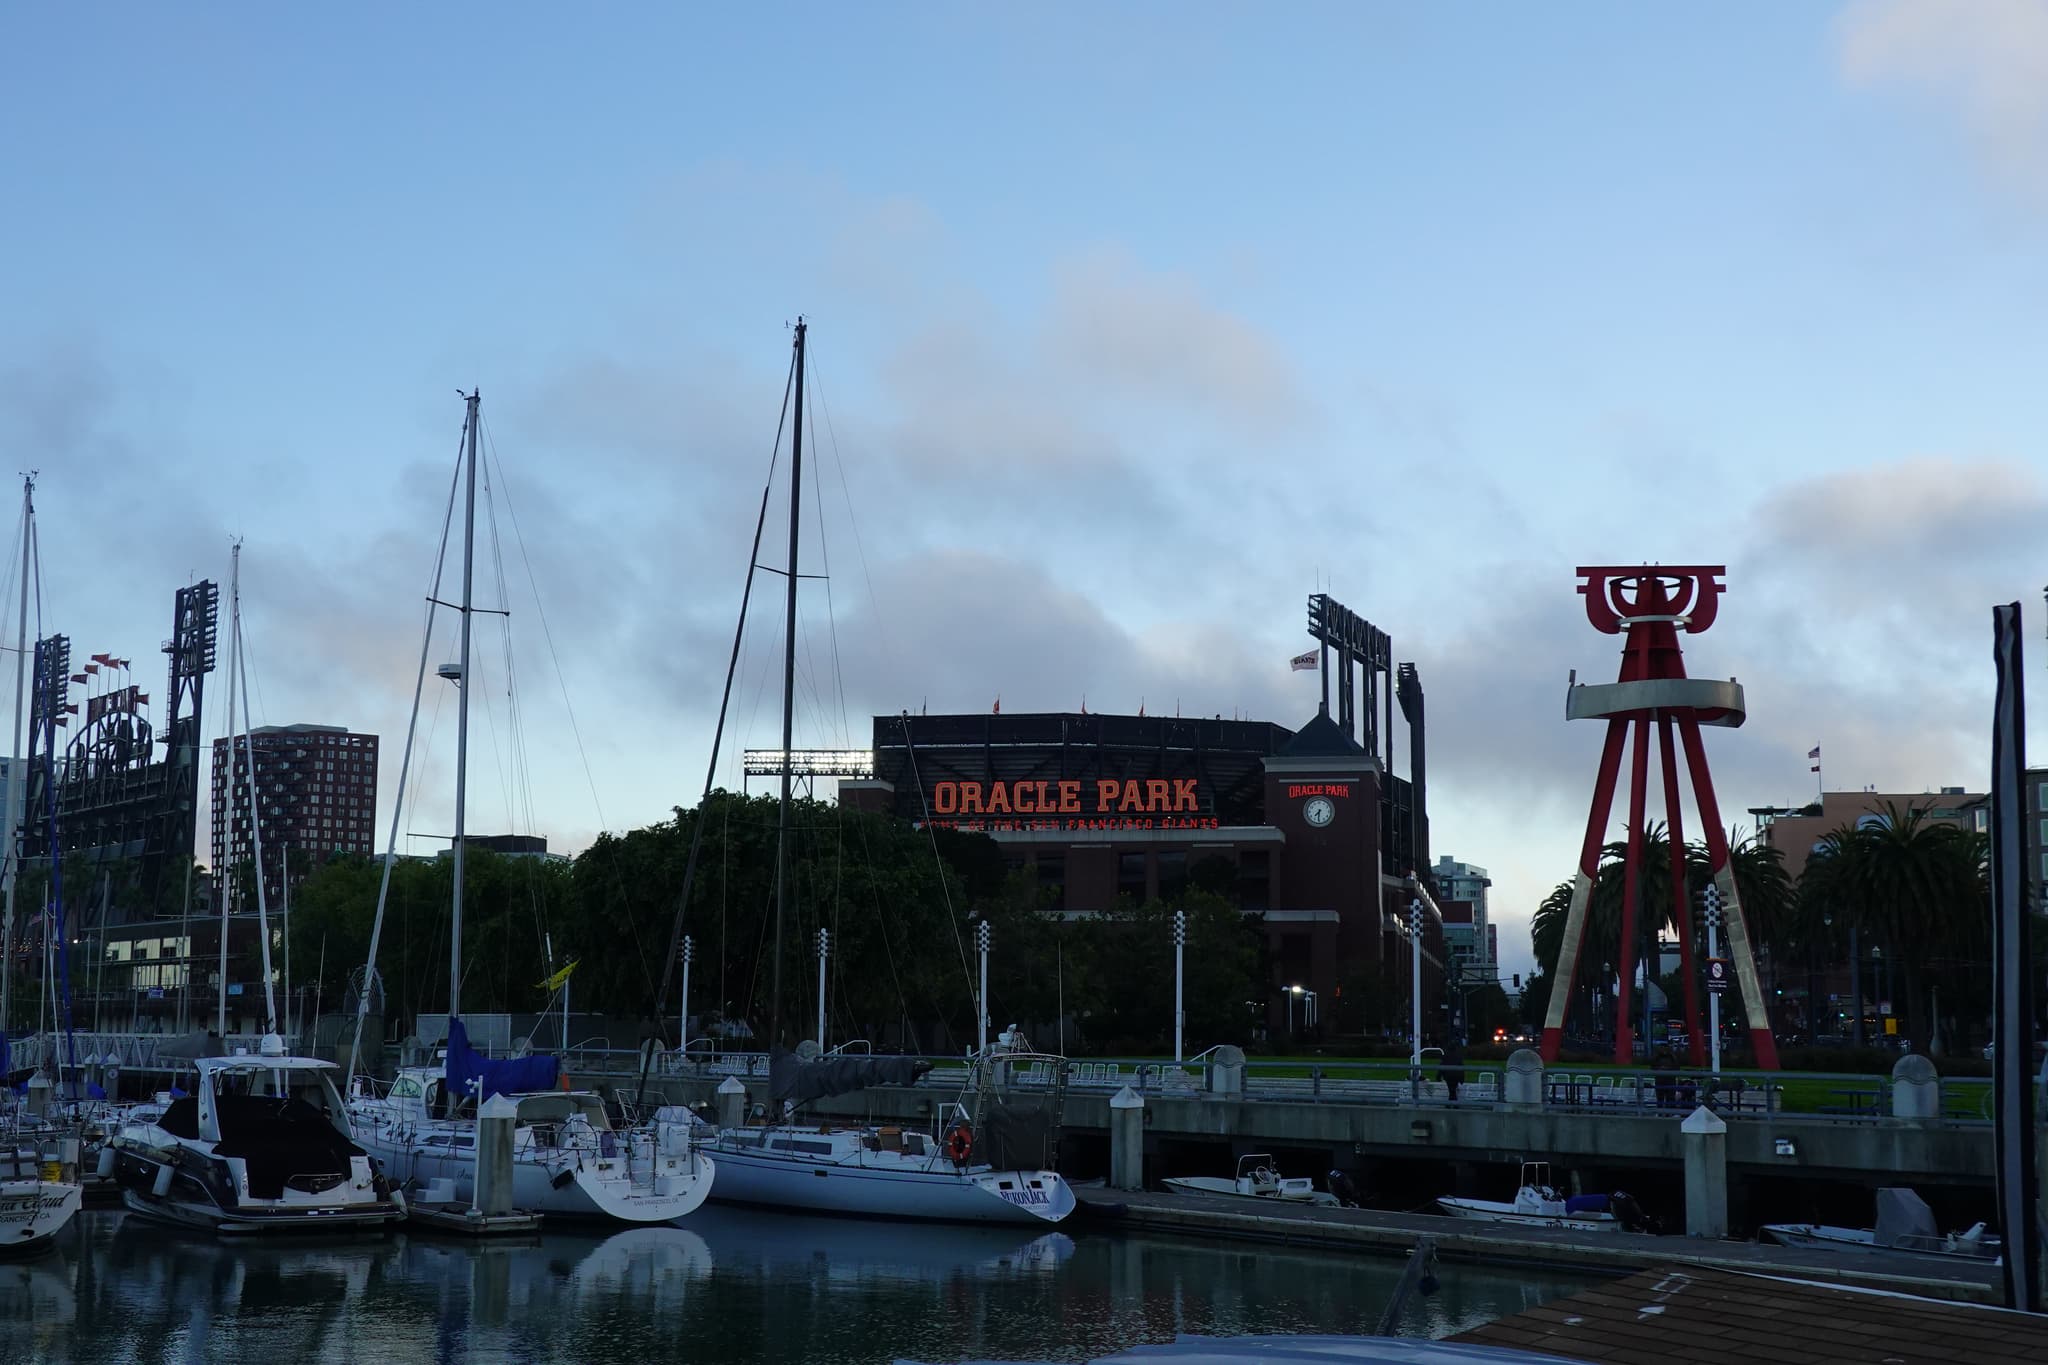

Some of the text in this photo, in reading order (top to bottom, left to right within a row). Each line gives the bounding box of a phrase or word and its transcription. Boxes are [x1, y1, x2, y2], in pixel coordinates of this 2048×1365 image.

[934, 778, 1199, 814] ORACLE PARK
[1289, 784, 1349, 799] ORACLE PARK
[995, 819, 1022, 830] THE
[1031, 819, 1060, 830] SAN
[1068, 818, 1153, 830] FRANCISCO
[1162, 818, 1219, 830] GIANTS
